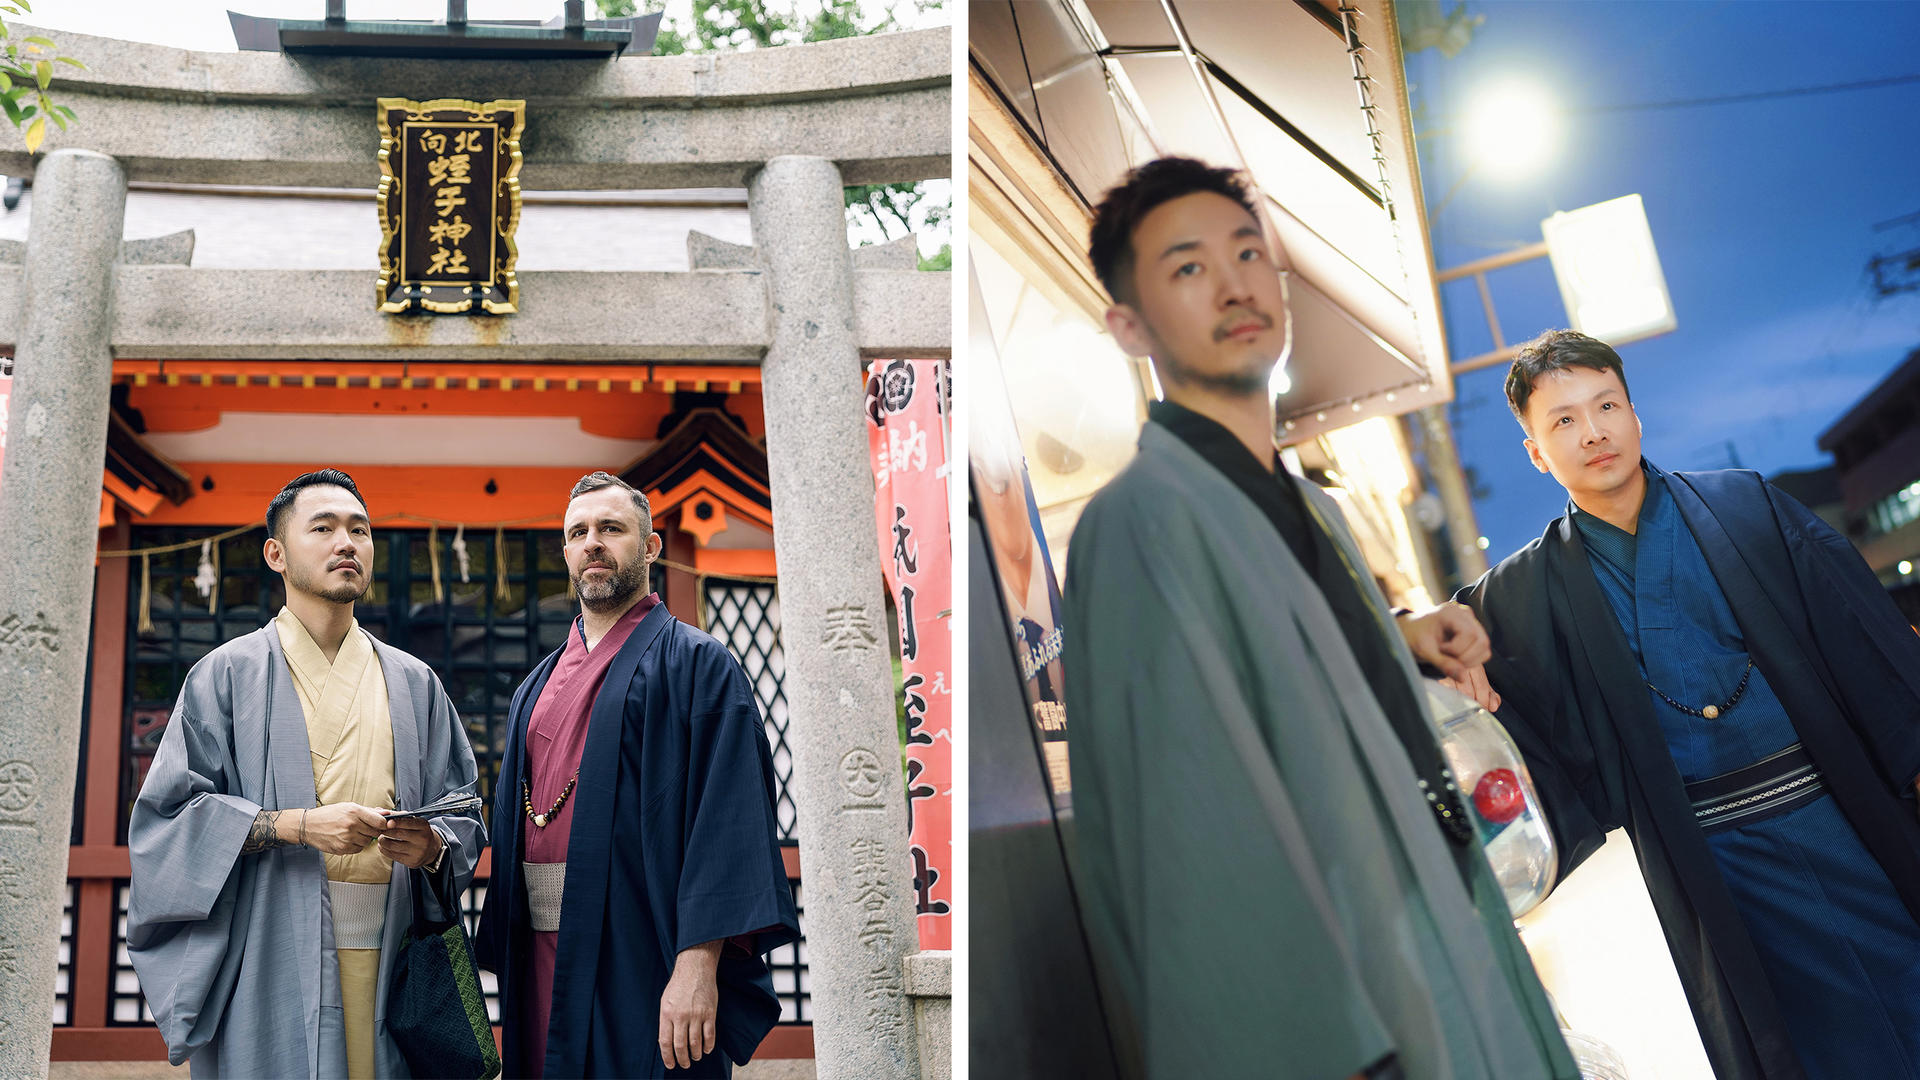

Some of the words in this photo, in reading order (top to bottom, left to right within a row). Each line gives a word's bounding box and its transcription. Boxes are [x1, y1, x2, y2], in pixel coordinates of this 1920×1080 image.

[418, 129, 483, 155] 北向
[426, 154, 473, 275] 蛭子神社
[822, 601, 878, 655] 奉
